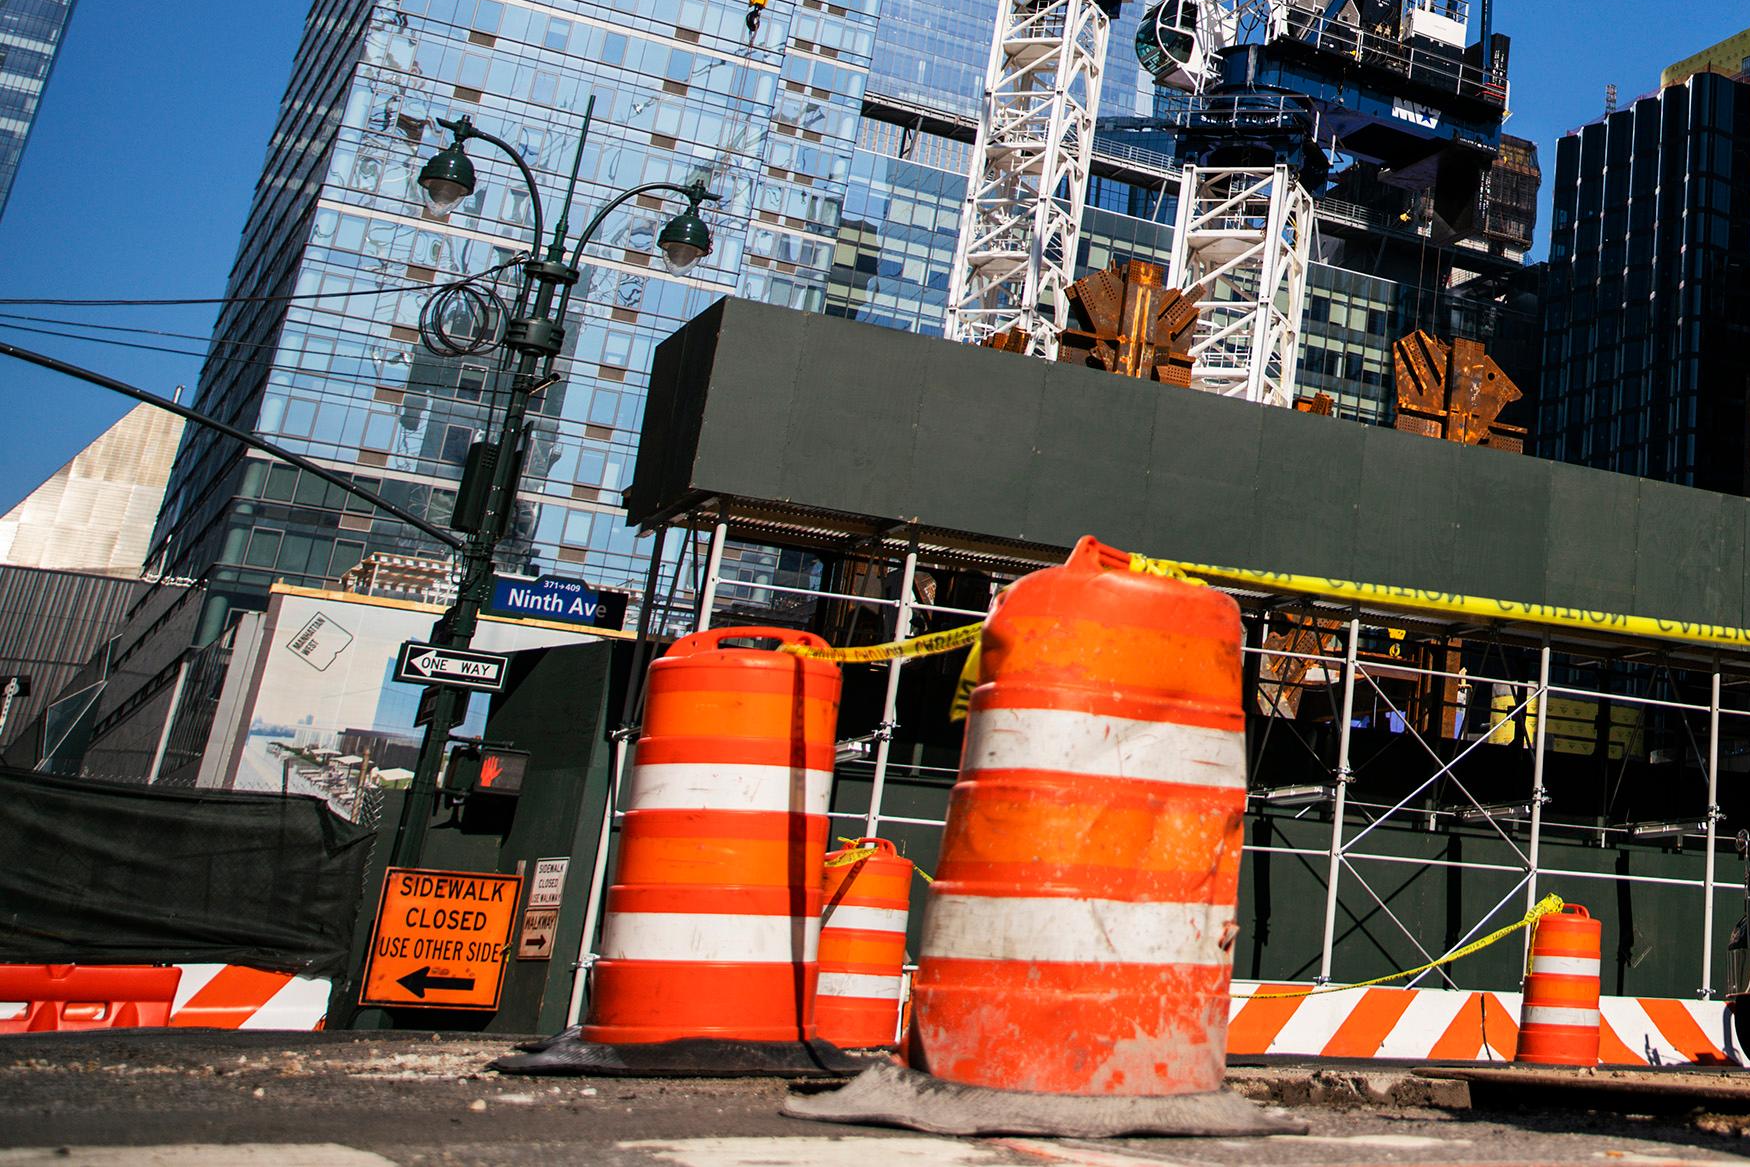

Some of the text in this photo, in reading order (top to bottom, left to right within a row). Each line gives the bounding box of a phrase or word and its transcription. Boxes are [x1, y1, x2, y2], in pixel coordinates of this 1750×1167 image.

[507, 588, 607, 618] Ninth Ave
[292, 617, 326, 650] MANHATTAN
[301, 638, 319, 656] WEST
[421, 657, 491, 676] ONE WAY
[539, 863, 565, 874] SIDEWALK
[400, 876, 505, 902] SIDEWALK
[539, 878, 559, 888] CLOSED
[405, 907, 487, 931] CLOSED
[525, 915, 555, 929] WALKWAY
[379, 936, 502, 963] USE OTHER SIDE
